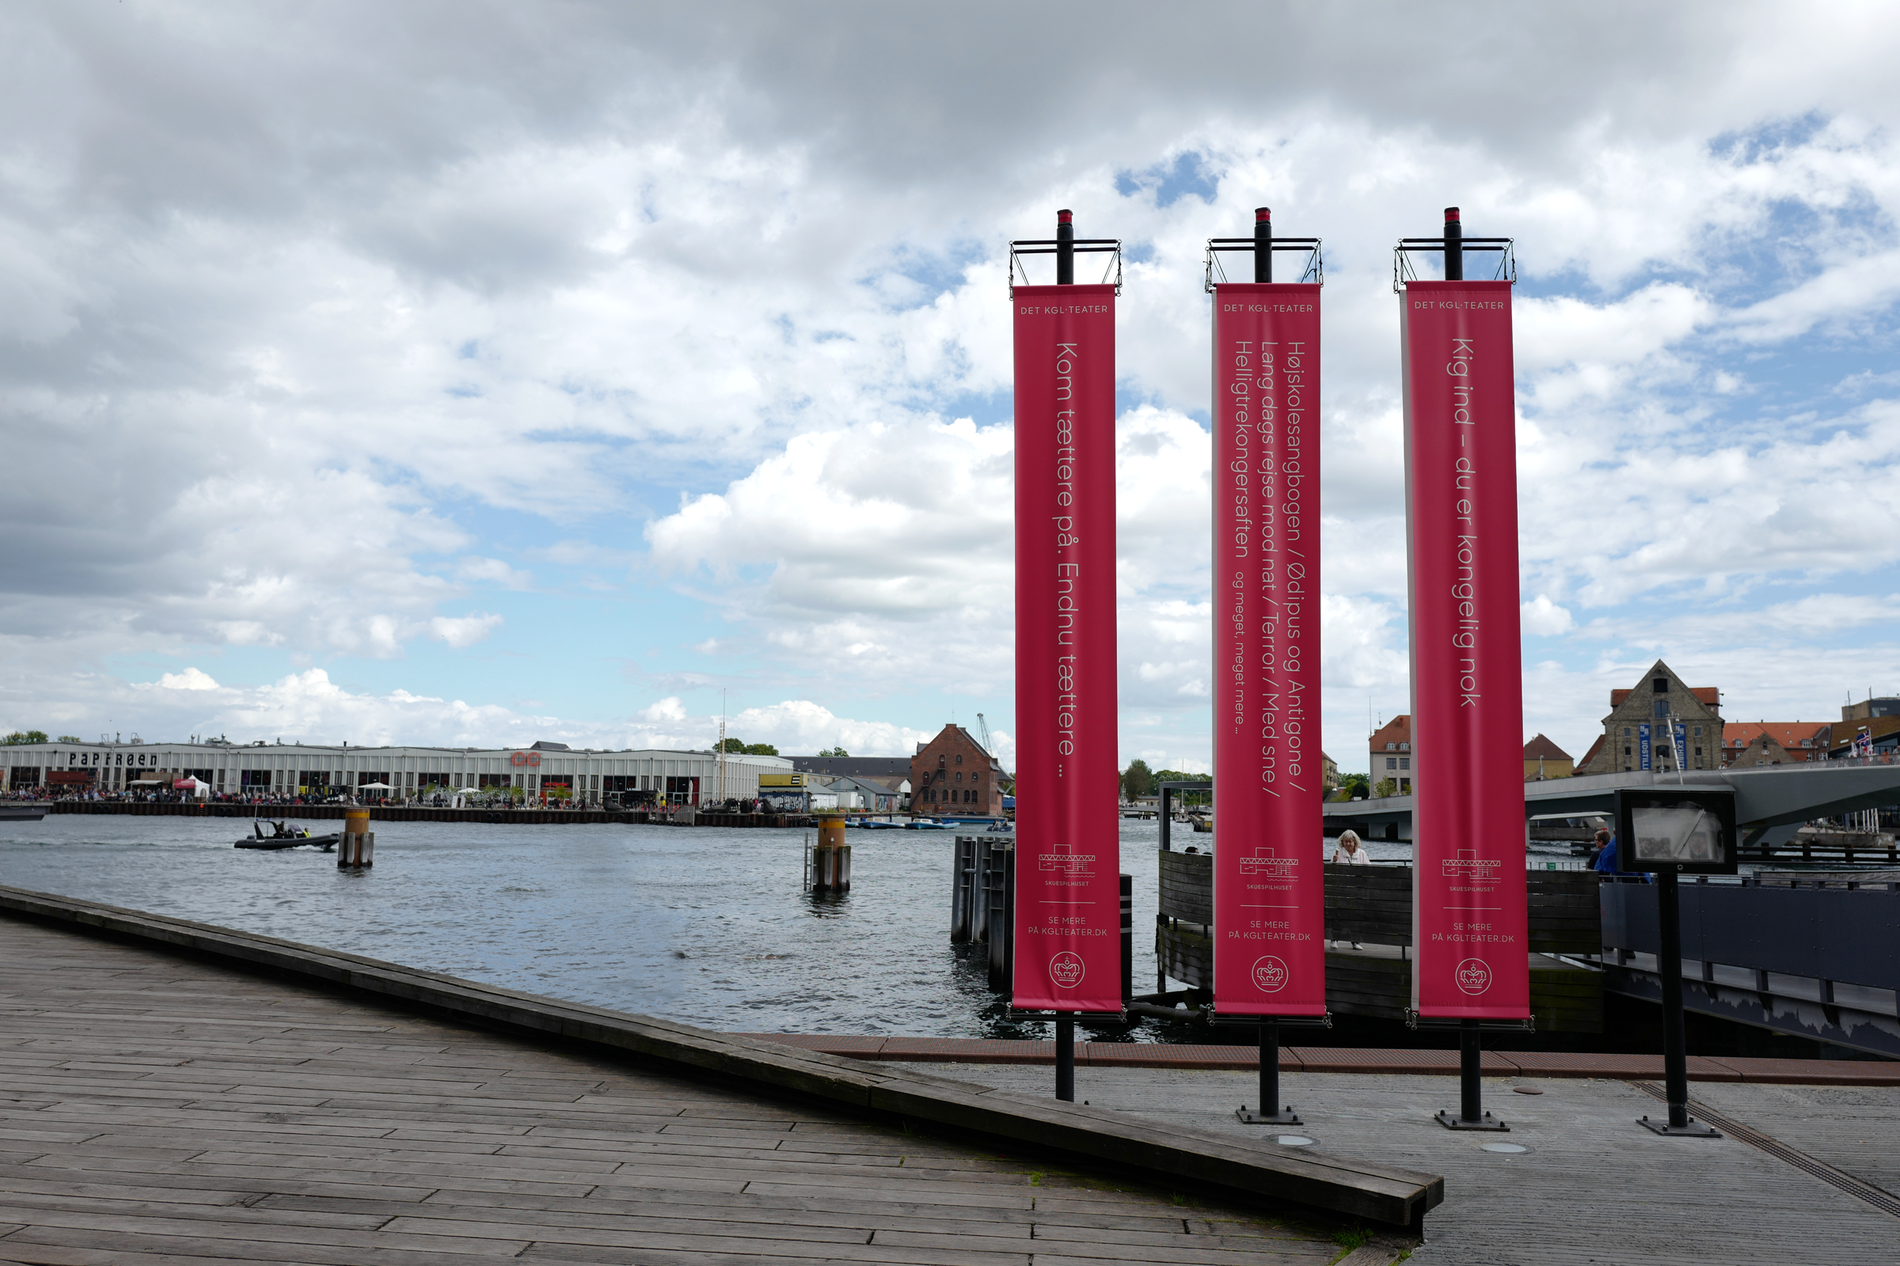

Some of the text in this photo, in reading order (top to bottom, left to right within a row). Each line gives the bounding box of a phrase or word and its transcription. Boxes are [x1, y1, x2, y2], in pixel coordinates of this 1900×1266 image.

[1021, 306, 1040, 315] DET
[1224, 303, 1244, 313] DET
[1414, 300, 1435, 310] DET
[1056, 342, 1078, 401] Kom
[1257, 341, 1279, 391] Lang
[1446, 338, 1474, 377] Kig
[1257, 395, 1279, 445] dags
[1453, 386, 1475, 424] ind
[1056, 408, 1076, 507] tættere
[1230, 340, 1253, 558] Helligtrekongersaften
[1282, 341, 1306, 542] Højskolesangbogen
[1257, 450, 1278, 499] rejse
[1455, 457, 1477, 490] du
[1262, 504, 1279, 553] mod
[1456, 499, 1472, 526] er
[1052, 516, 1080, 554] på.
[1232, 571, 1244, 589] og
[1262, 558, 1278, 591] nat
[1451, 535, 1480, 649] kongelig
[1057, 562, 1079, 646] Endnu
[1231, 592, 1246, 639] meget,
[1283, 562, 1306, 639] Ødipus
[1261, 611, 1280, 675] Terror
[1283, 646, 1301, 673] og
[1231, 642, 1246, 687] meget
[1459, 658, 1481, 707] nok
[1058, 653, 1077, 756] tættere
[1262, 693, 1280, 740] Med
[1283, 679, 1306, 777] Antigone
[511, 751, 541, 767] CC
[1262, 745, 1276, 784] sne
[1028, 926, 1108, 937] PÅ KGLTEATER.DK
[1048, 916, 1086, 925] SE MERE
[1228, 930, 1311, 941] PÅ KGLTEATER.DK
[1250, 920, 1290, 929] SE MERE
[1432, 933, 1515, 943] PÅ KGLTEATER.DK
[1453, 922, 1492, 931] SE MERE
